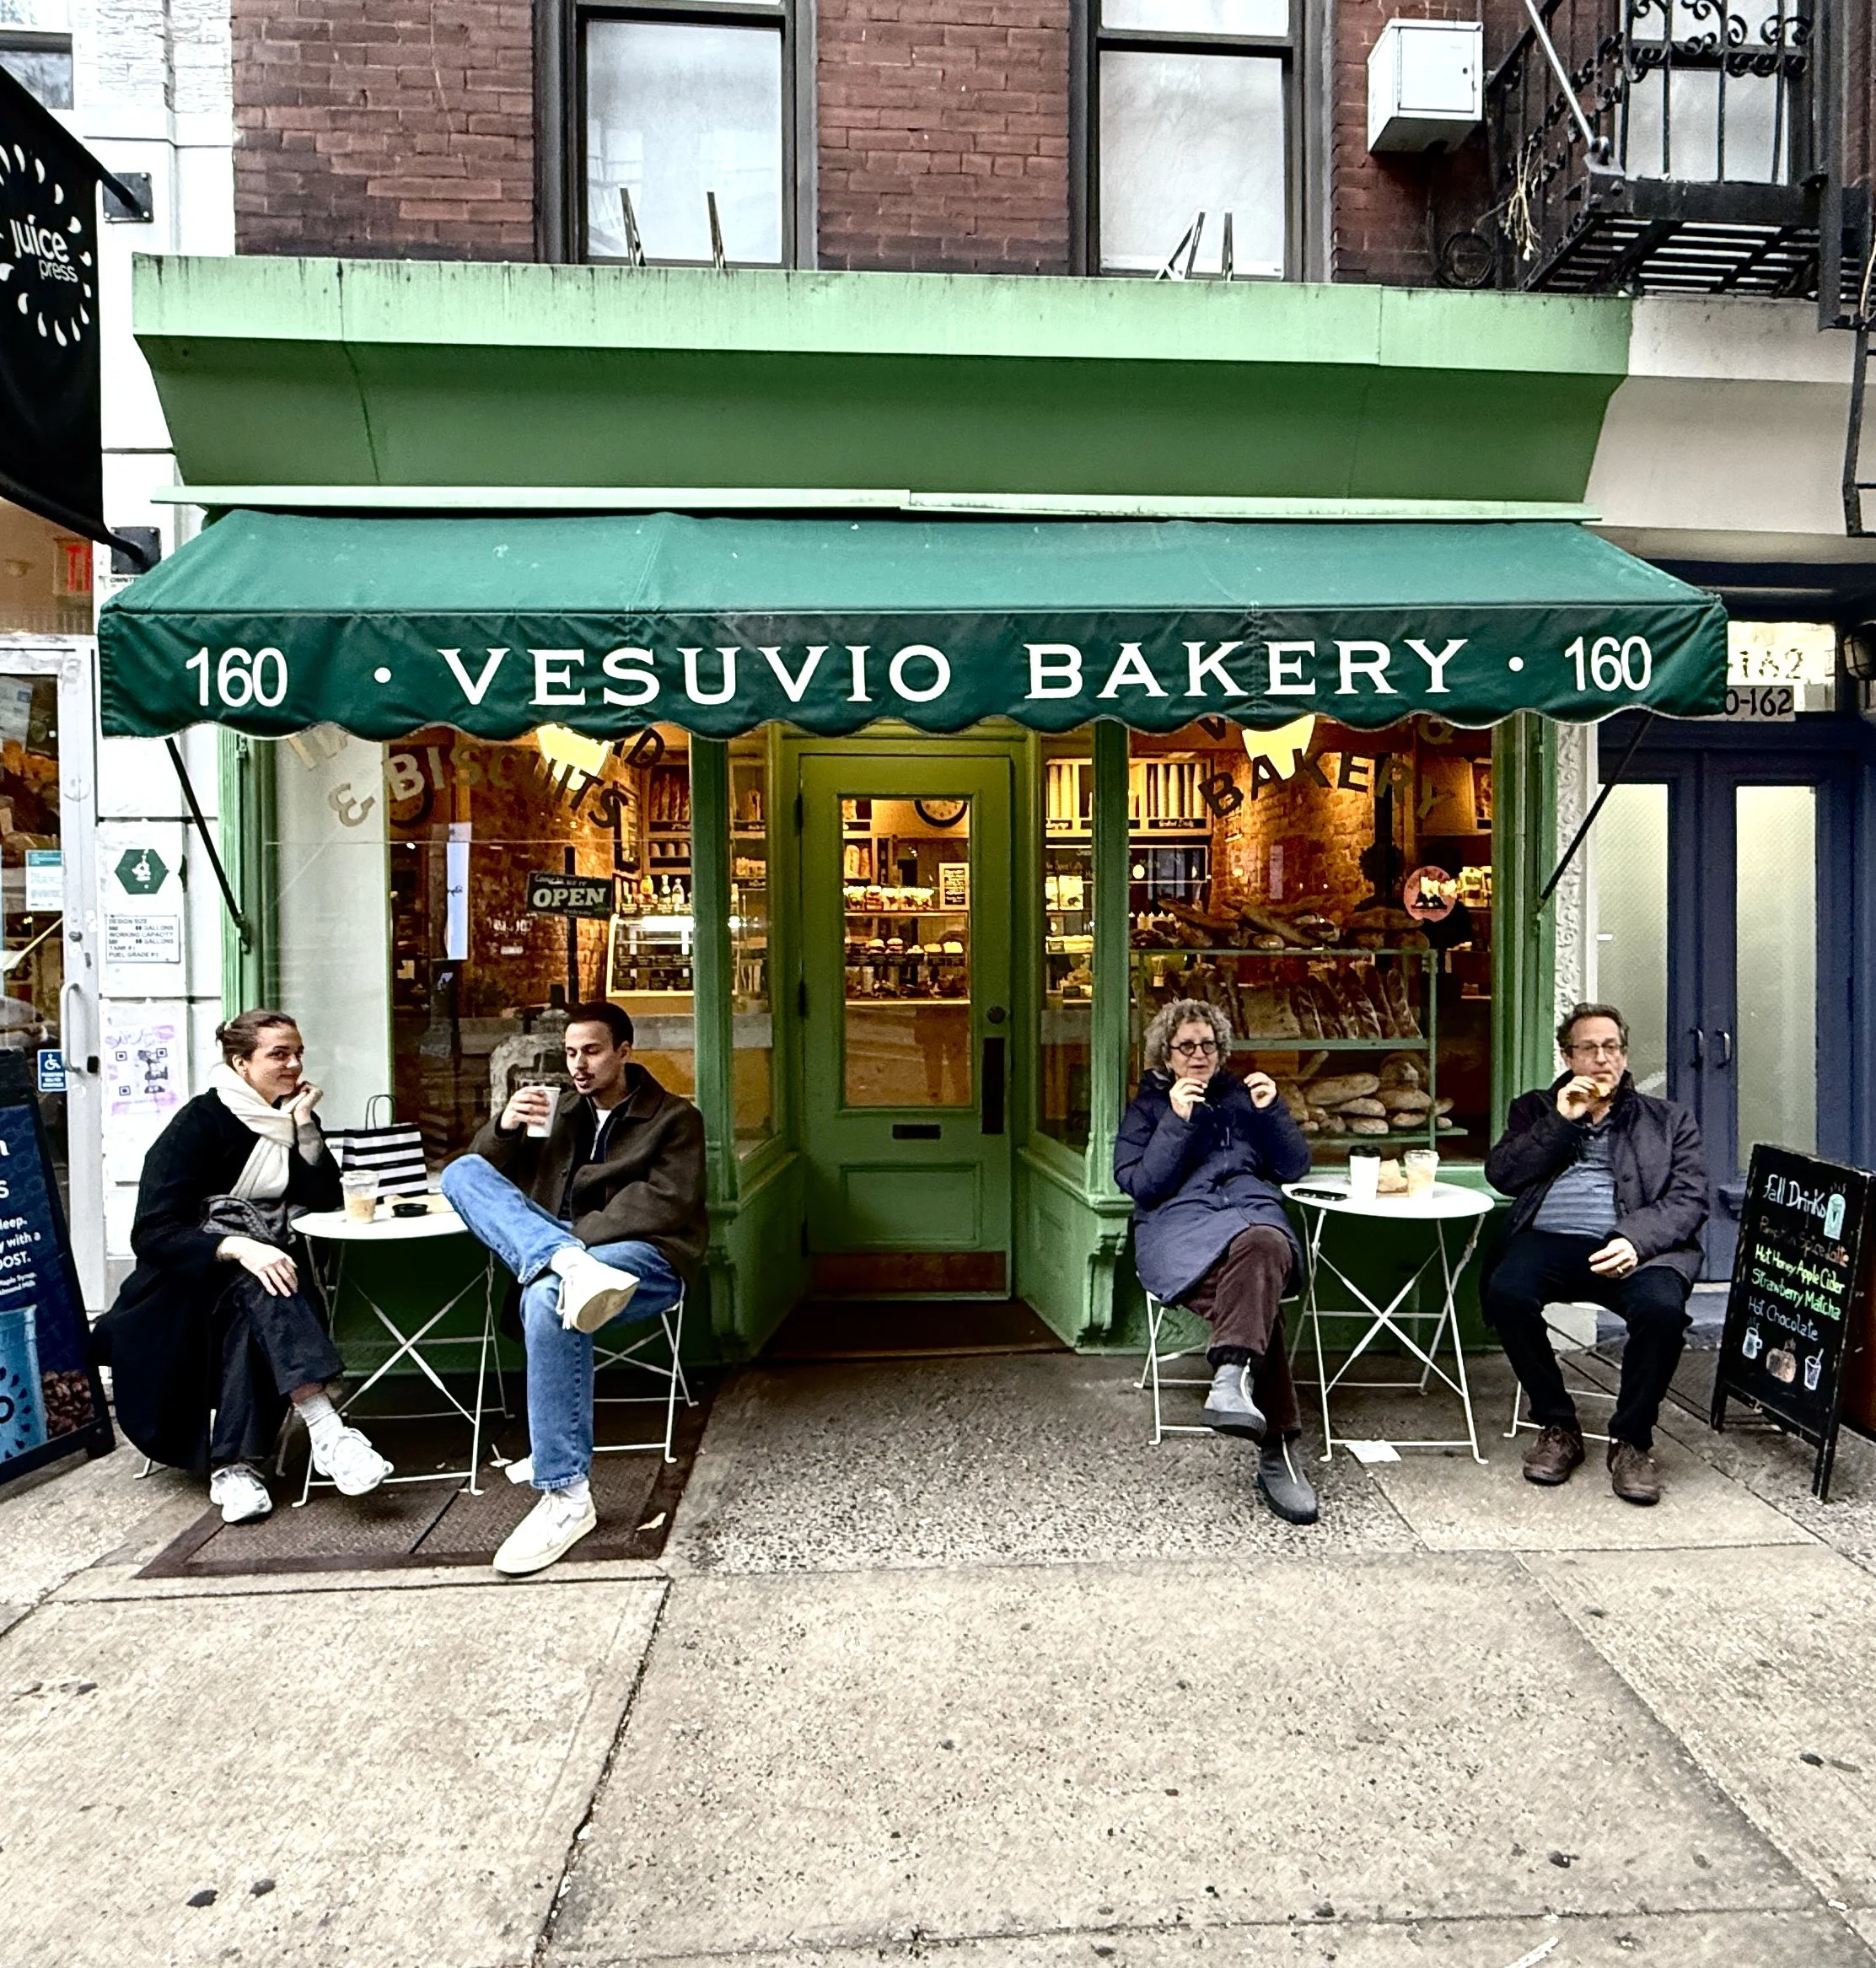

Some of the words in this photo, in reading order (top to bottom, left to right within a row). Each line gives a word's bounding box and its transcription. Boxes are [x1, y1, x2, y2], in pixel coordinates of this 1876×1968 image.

[38, 259, 79, 283] press
[185, 647, 288, 707] 160
[437, 644, 951, 707] VESUVIO
[1023, 638, 1468, 699] BAKERY
[1564, 636, 1653, 691] 160
[1197, 747, 1455, 820] BAKERY
[532, 887, 607, 908] OPEN
[7, 1231, 33, 1248] with
[1751, 1267, 1804, 1308] Strawberry
[1804, 1289, 1842, 1321] Matcha
[1796, 1259, 1820, 1286] Apple
[1820, 1267, 1846, 1294] Cider
[1749, 1295, 1766, 1316] Hot
[1766, 1304, 1820, 1342] Chocolate
